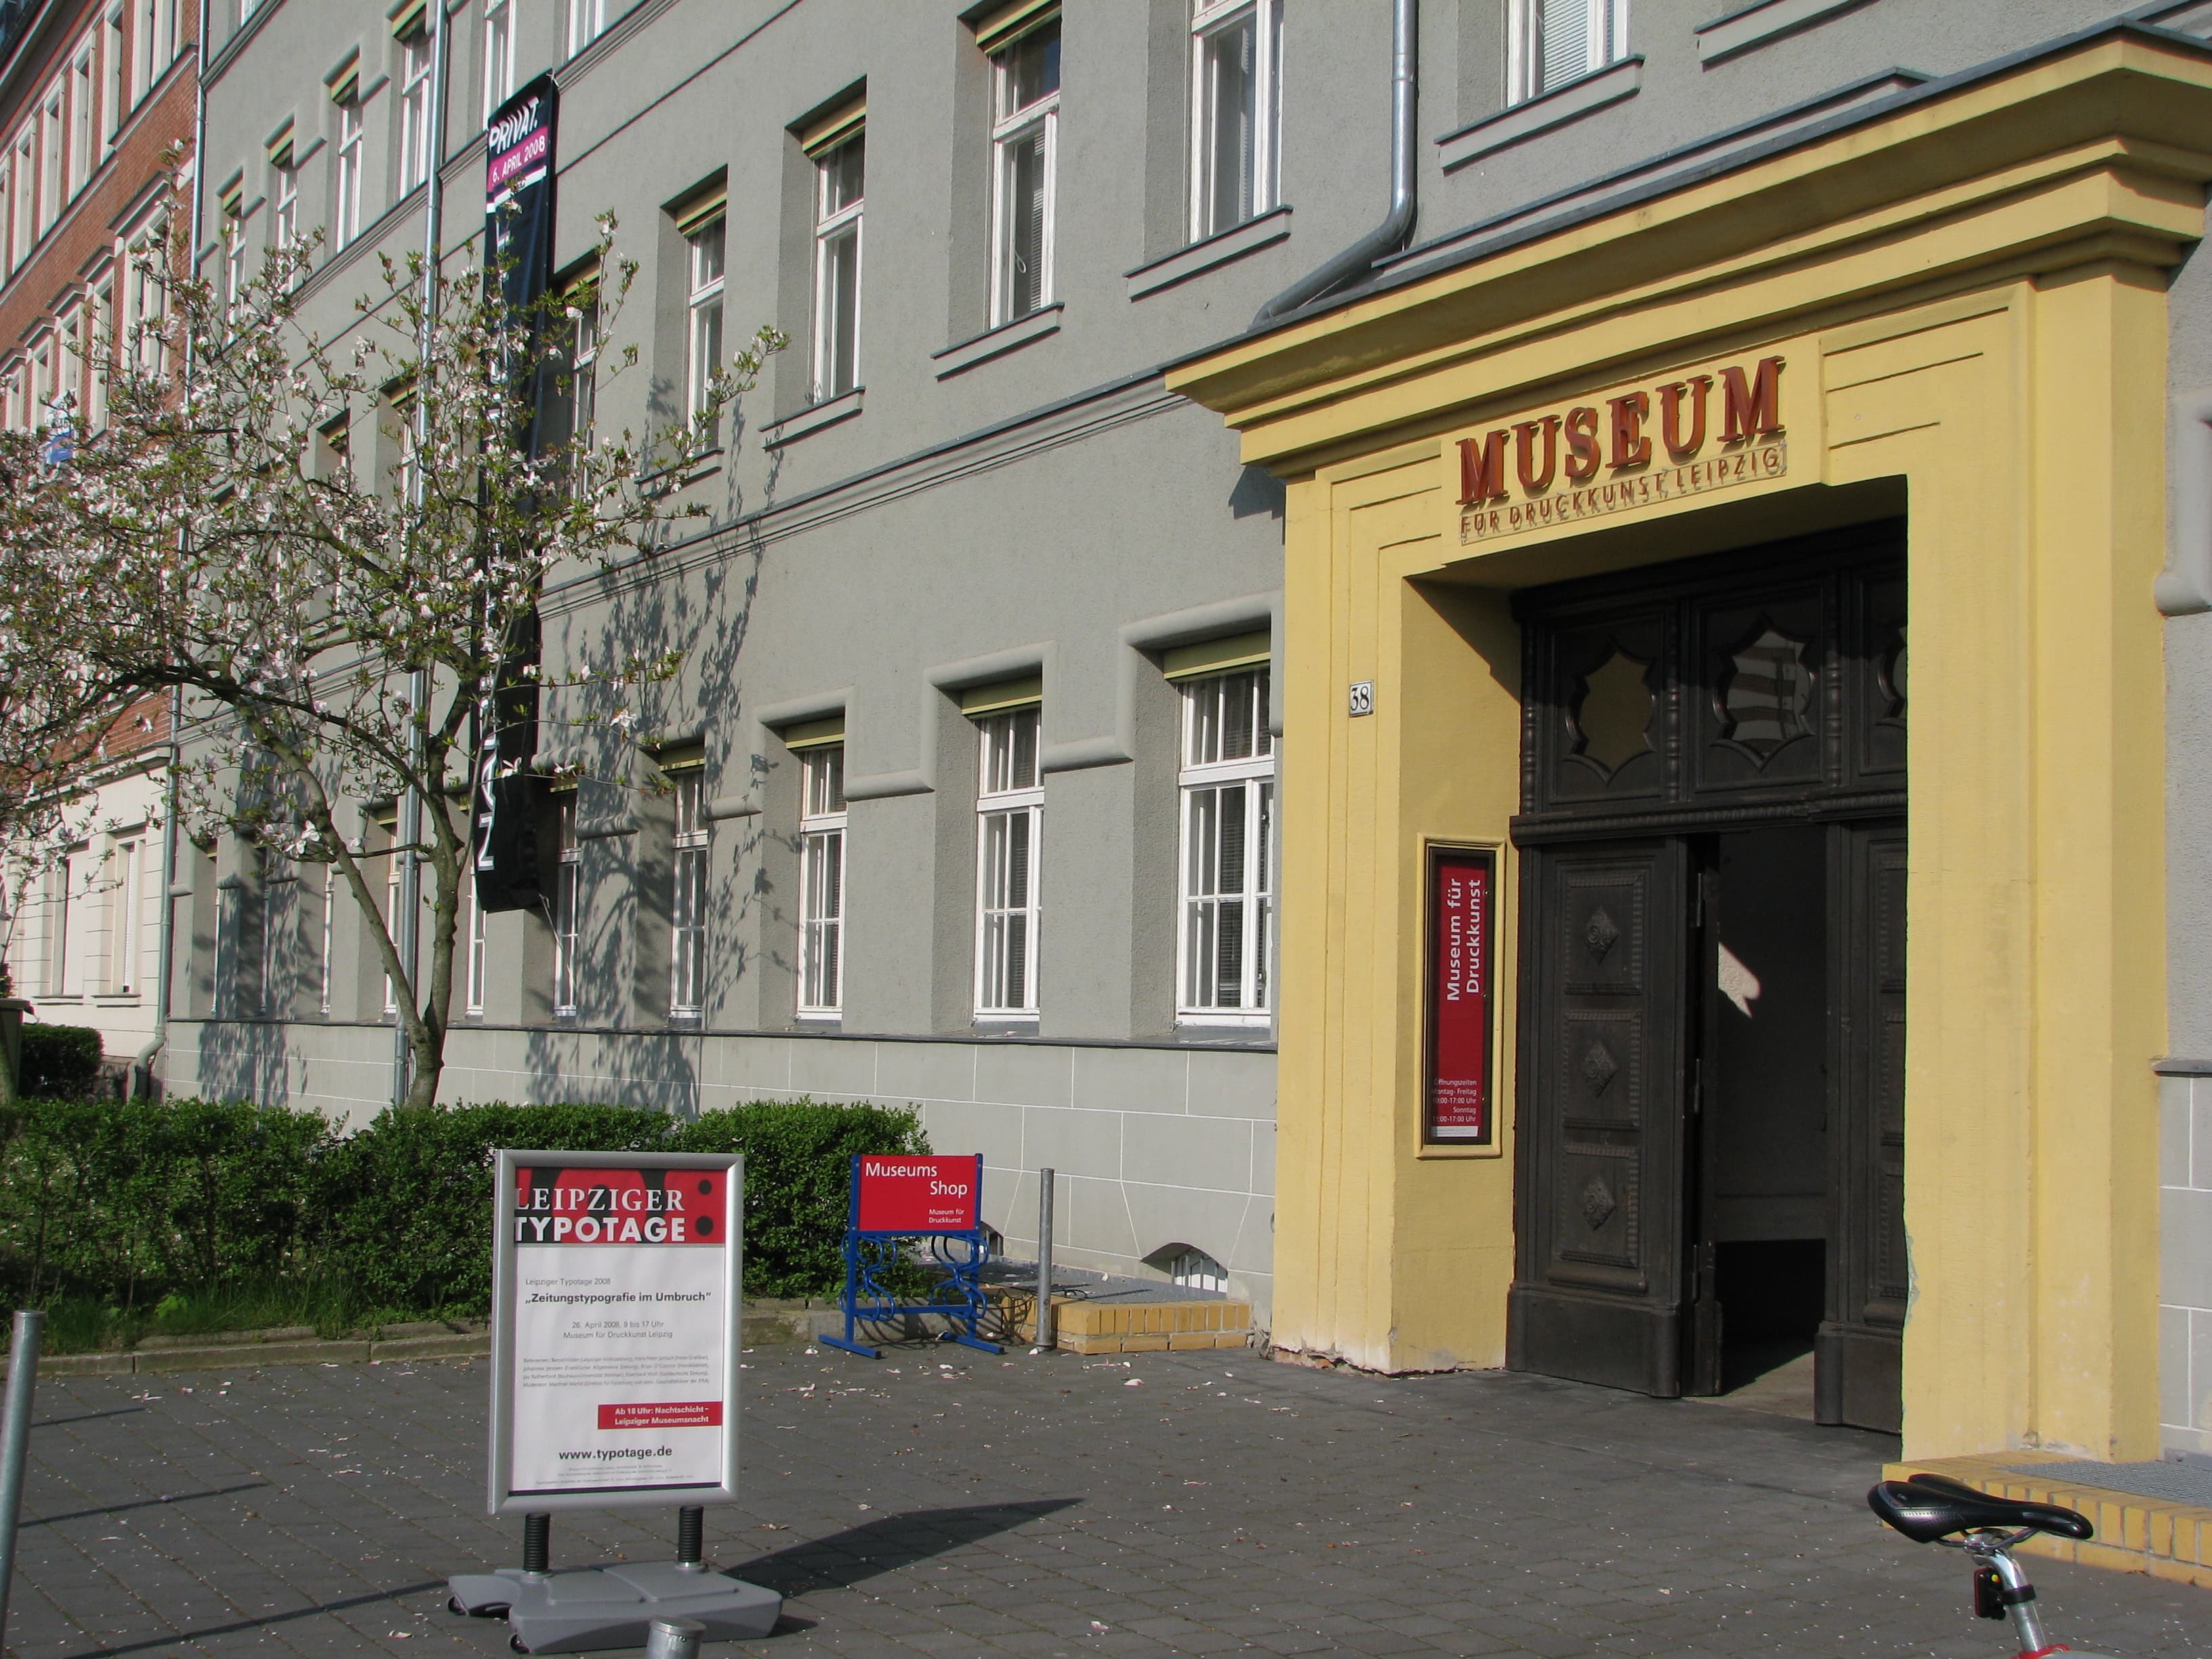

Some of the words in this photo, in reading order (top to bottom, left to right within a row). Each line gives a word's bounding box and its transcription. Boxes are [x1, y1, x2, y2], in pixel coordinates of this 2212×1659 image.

[489, 96, 539, 155] PRIVAT.
[492, 167, 499, 184] 6.
[501, 152, 522, 178] APRIL
[524, 135, 546, 161] 2008
[1455, 355, 1786, 505] MUSEUM
[1510, 472, 1664, 524] DRUCKKUNST
[1677, 447, 1778, 488] LEIPZIG
[1350, 686, 1370, 711] 38
[1447, 878, 1462, 909] für
[1466, 880, 1481, 994] Druckkunst
[1446, 915, 1461, 1002] Museum
[1457, 1088, 1477, 1097] Freitag
[1452, 1106, 1477, 1115] Sonntag
[865, 1162, 938, 1177] Museums
[930, 1180, 968, 1198] Shop
[515, 1188, 685, 1211] LEIPZIGER
[515, 1216, 685, 1242] TYPOTAGE
[560, 1278, 592, 1286] Typotage
[525, 1292, 636, 1304] „Zeitungstypografie
[639, 1293, 653, 1301] im
[656, 1292, 712, 1301] Umbruch“
[649, 1330, 673, 1338] Leipzig
[655, 1406, 704, 1414] Nachtschicht
[615, 1418, 650, 1426] Leipziger
[651, 1416, 709, 1424] Museumsnacht
[558, 1446, 673, 1461] www.typotage.de
